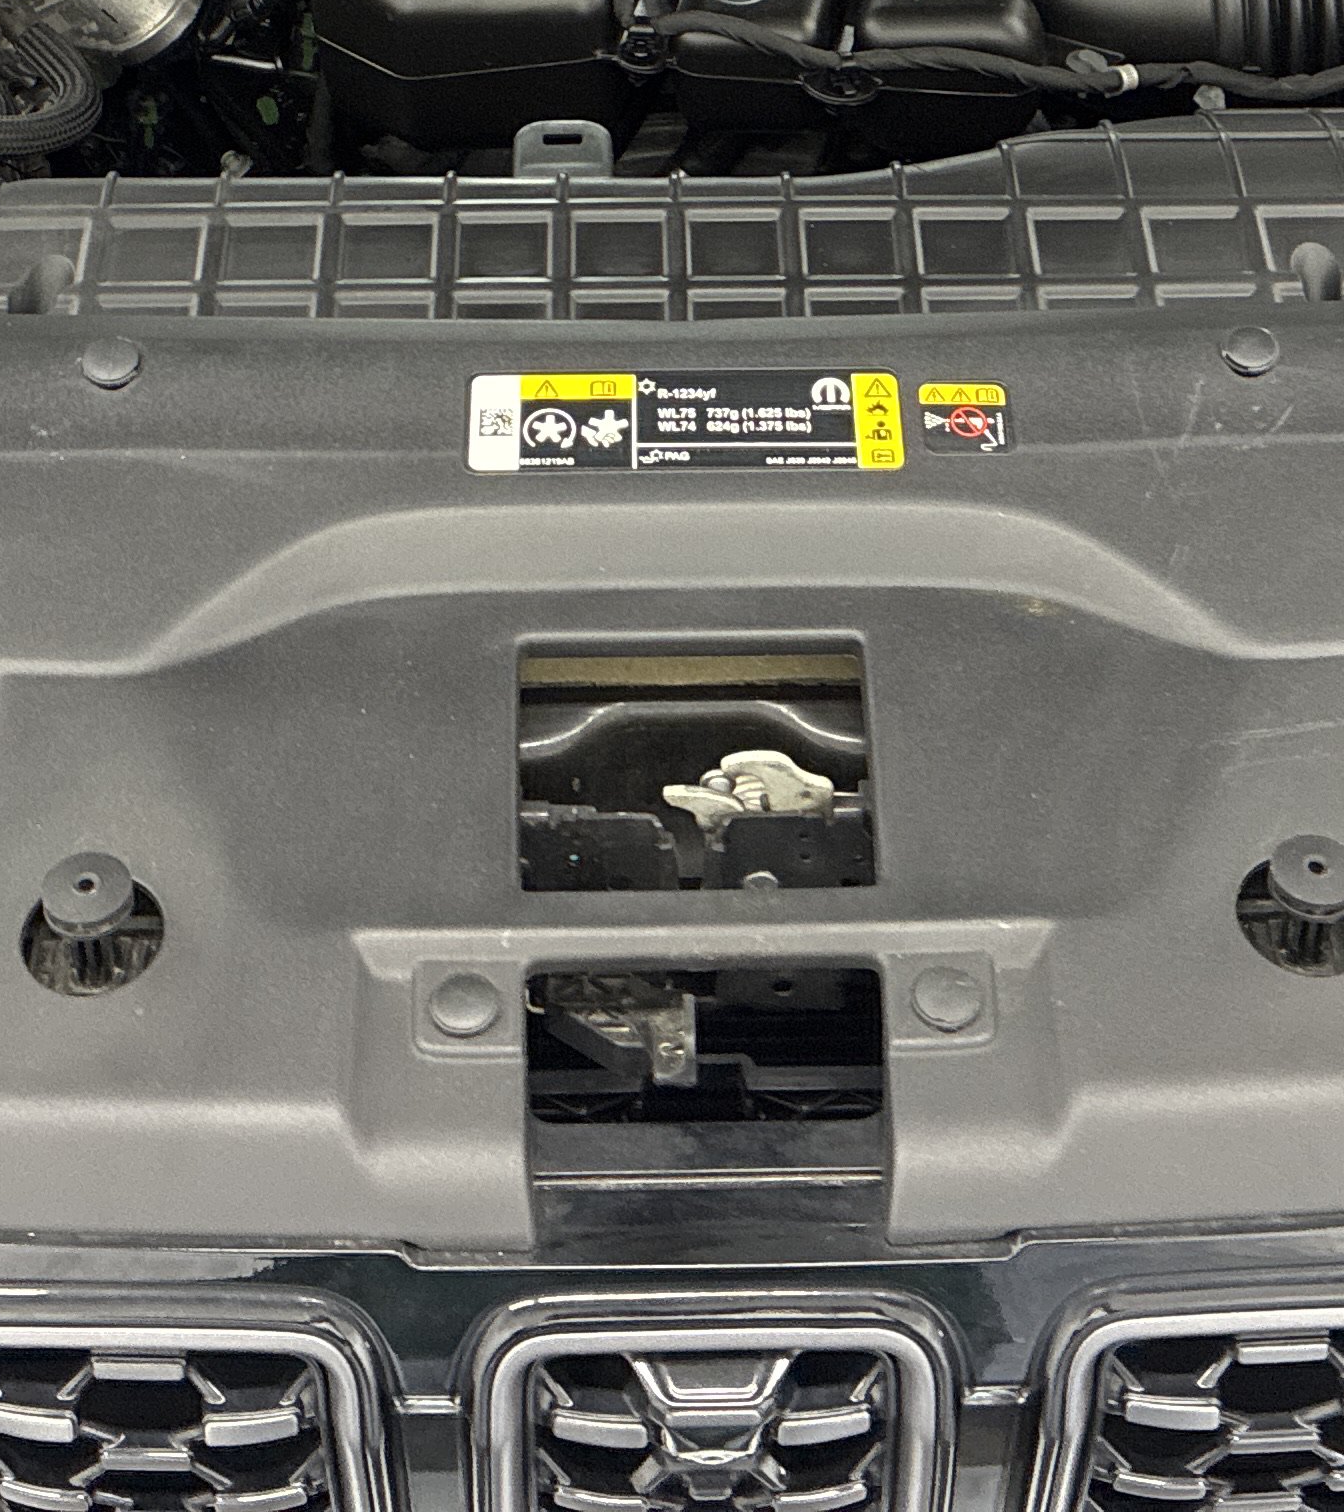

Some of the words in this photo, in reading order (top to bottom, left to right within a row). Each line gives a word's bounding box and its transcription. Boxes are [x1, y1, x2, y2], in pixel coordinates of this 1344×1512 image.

[657, 388, 717, 401] R-1234yf
[657, 408, 697, 419] WL75
[706, 408, 739, 421] 737g
[742, 408, 783, 420] (1.625
[785, 408, 812, 420] lbs)
[657, 421, 697, 432] WL74
[706, 421, 740, 434] 624g
[742, 421, 784, 433] (1.375
[785, 421, 812, 433] lbs)
[664, 451, 691, 461] PAG
